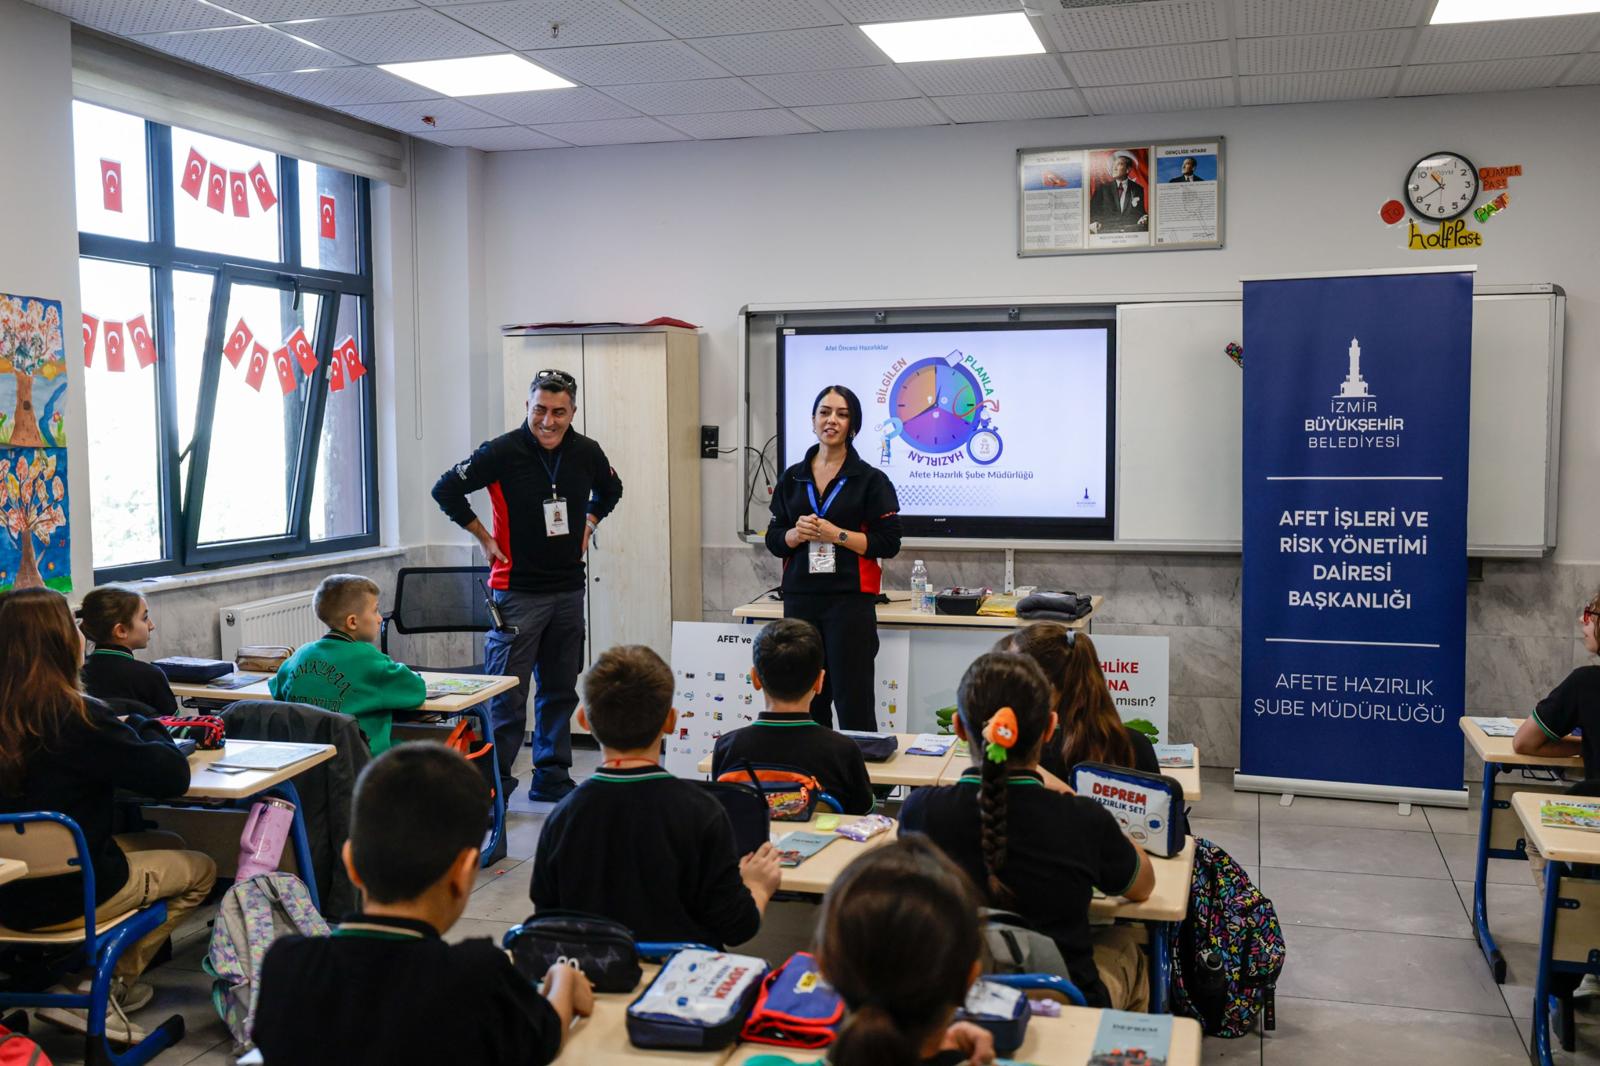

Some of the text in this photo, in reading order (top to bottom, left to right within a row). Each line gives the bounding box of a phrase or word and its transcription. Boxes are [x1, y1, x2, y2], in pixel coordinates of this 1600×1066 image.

[1417, 171, 1427, 179] 10
[1464, 181, 1471, 189] 3
[1416, 195, 1424, 203] 8
[1424, 203, 1432, 211] 7
[1437, 205, 1445, 213] 6
[875, 357, 908, 404] BİLGİLEN
[964, 354, 995, 397] PLANLA
[1331, 399, 1377, 413] İZMİR
[1305, 415, 1404, 433] BÜYÜKŞEHİR
[1308, 434, 1400, 449] BELEDİYESİ
[907, 450, 964, 467] HAZIRLAN
[909, 470, 1034, 481] Afete Hazırlık Şube Müdürlüğü
[1279, 507, 1429, 530] AFET İŞLERİ VE
[1280, 533, 1427, 555] RİSK YÖNETİMİ
[1313, 561, 1392, 582] DAİRESİ
[1288, 589, 1411, 610] BAŞKANLIĞI
[717, 634, 740, 643] AFET
[1100, 658, 1139, 673] HLİKE
[1275, 673, 1434, 696] AFETE HAZIRLIK
[1115, 696, 1156, 707] mısın?
[1254, 698, 1445, 724] ŞUBE MÜDÜRLÜĞÜ
[1092, 782, 1147, 806] DEPREM
[1129, 805, 1146, 815] SETİ
